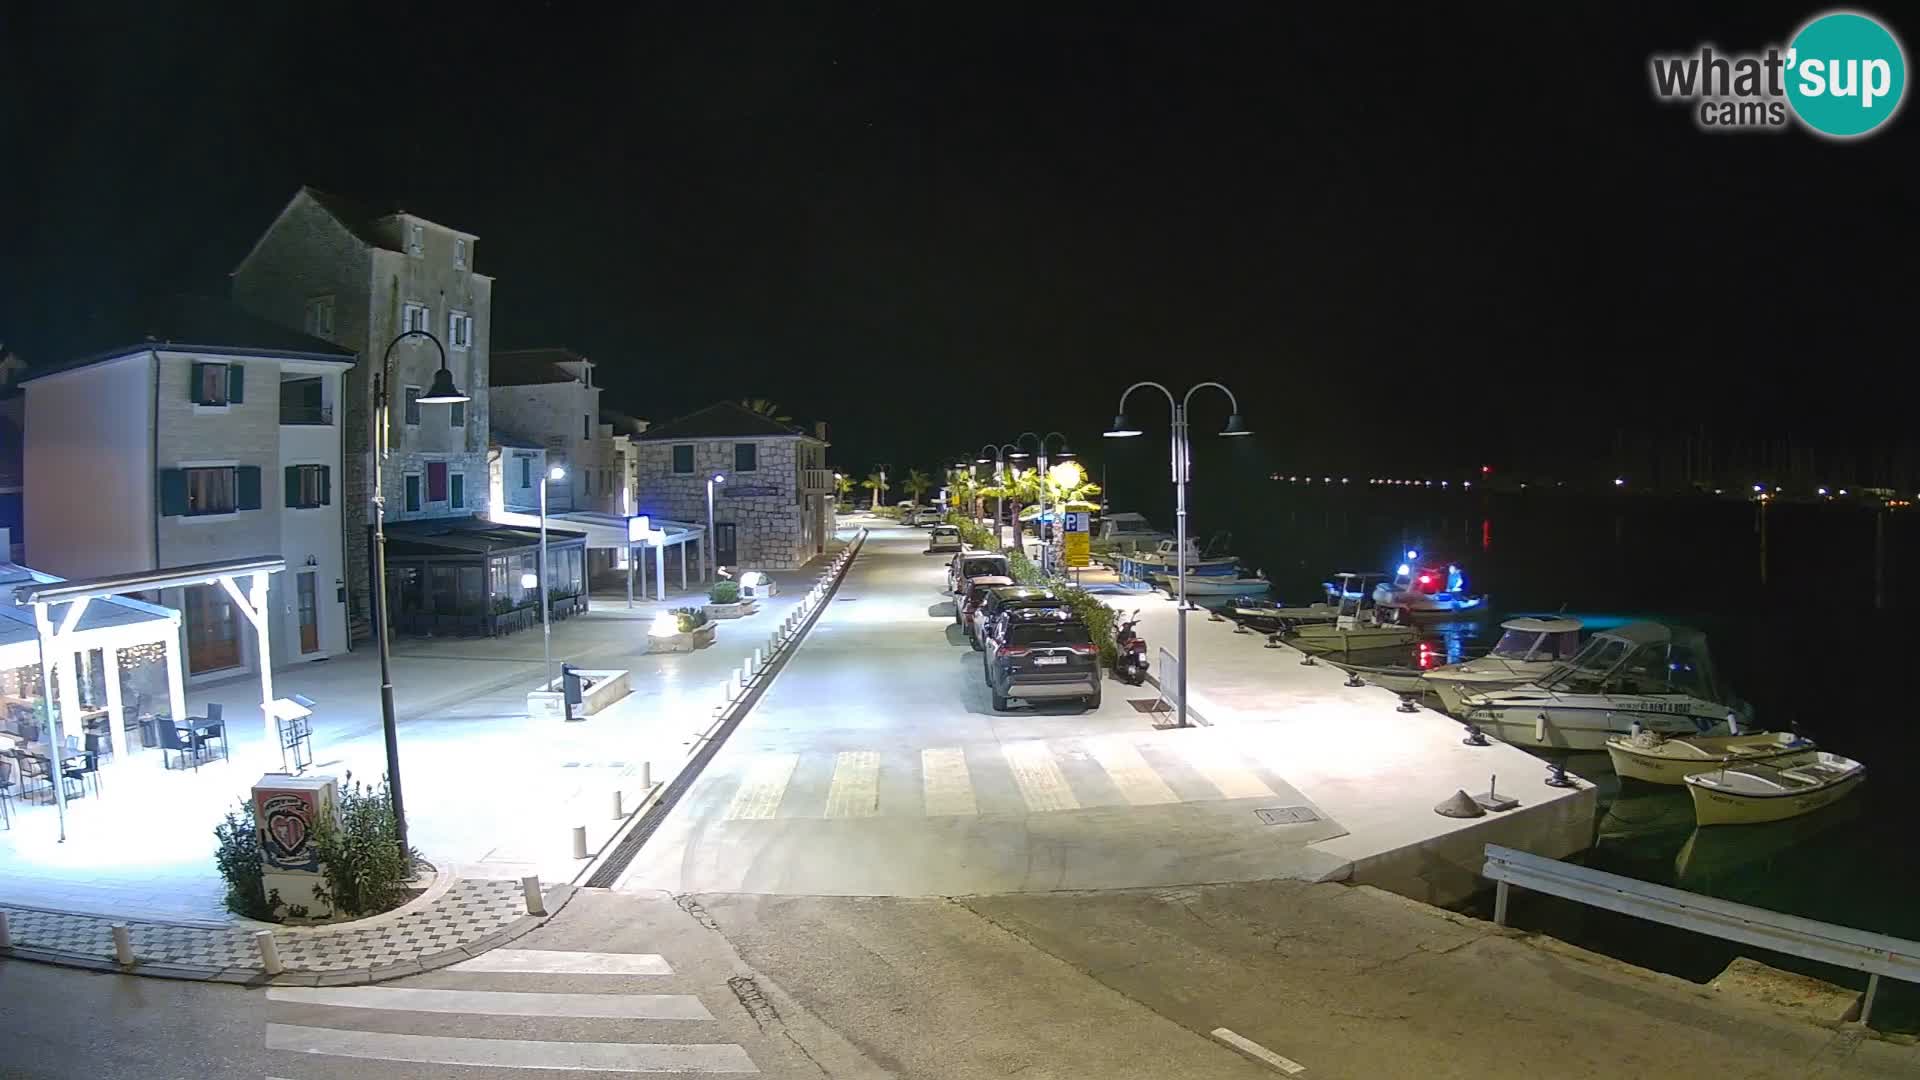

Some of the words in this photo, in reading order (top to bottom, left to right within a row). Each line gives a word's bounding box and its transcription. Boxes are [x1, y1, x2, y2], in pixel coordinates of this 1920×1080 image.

[1066, 514, 1076, 530] P
[1648, 703, 1667, 713] RENT
[1674, 703, 1691, 713] BOAT
